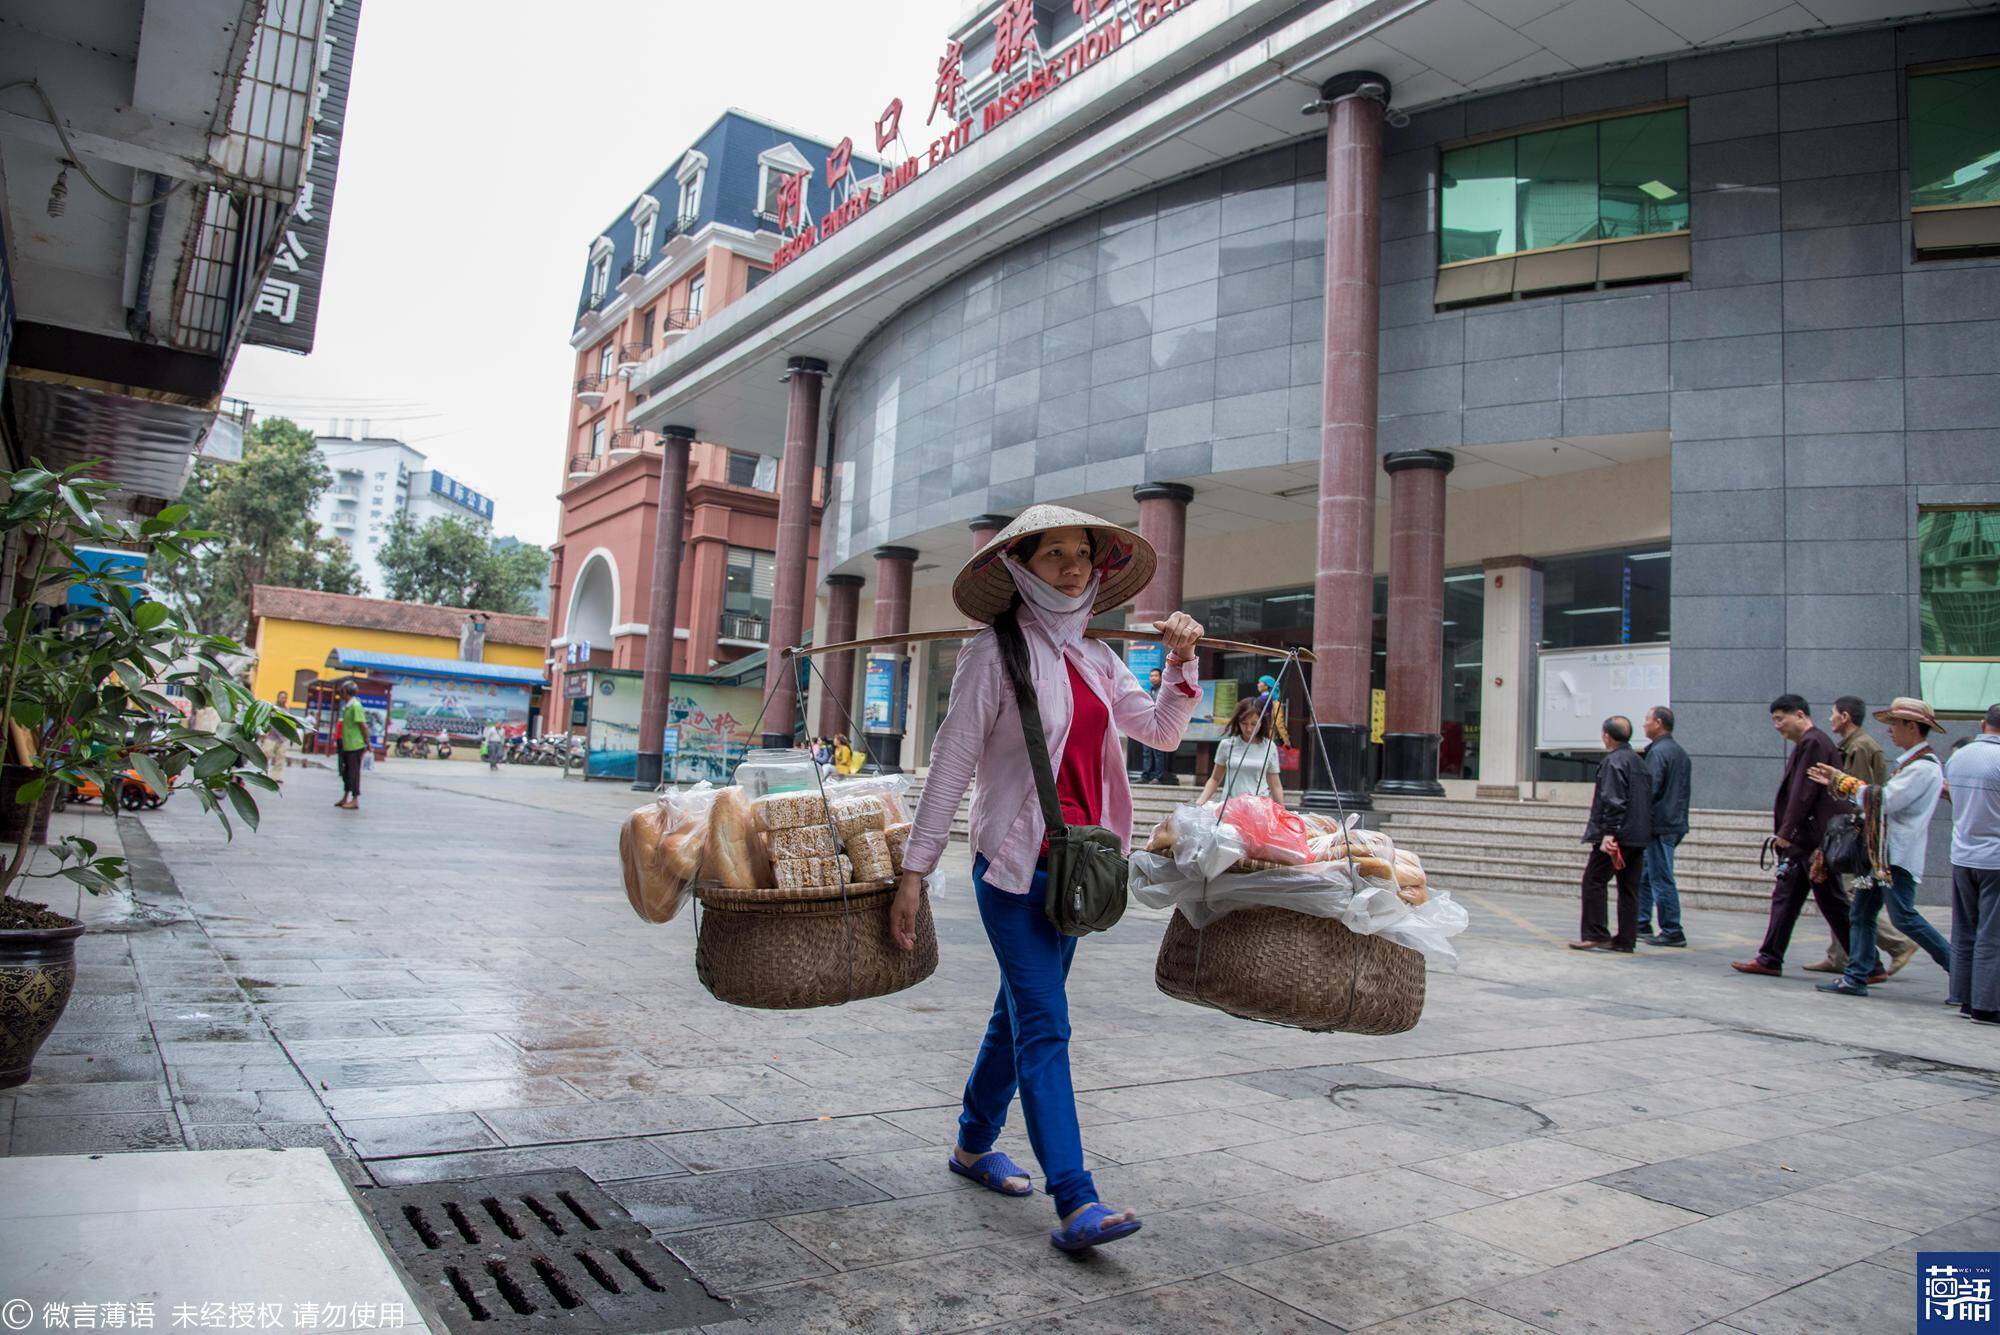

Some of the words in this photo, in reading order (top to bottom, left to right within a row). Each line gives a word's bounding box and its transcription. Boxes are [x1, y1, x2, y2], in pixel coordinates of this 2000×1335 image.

[822, 187, 871, 239] ENTRY
[883, 156, 918, 197] AND
[929, 116, 974, 167] EXIT
[983, 17, 1124, 131] INSPECTION
[25, 982, 48, 1004] 福
